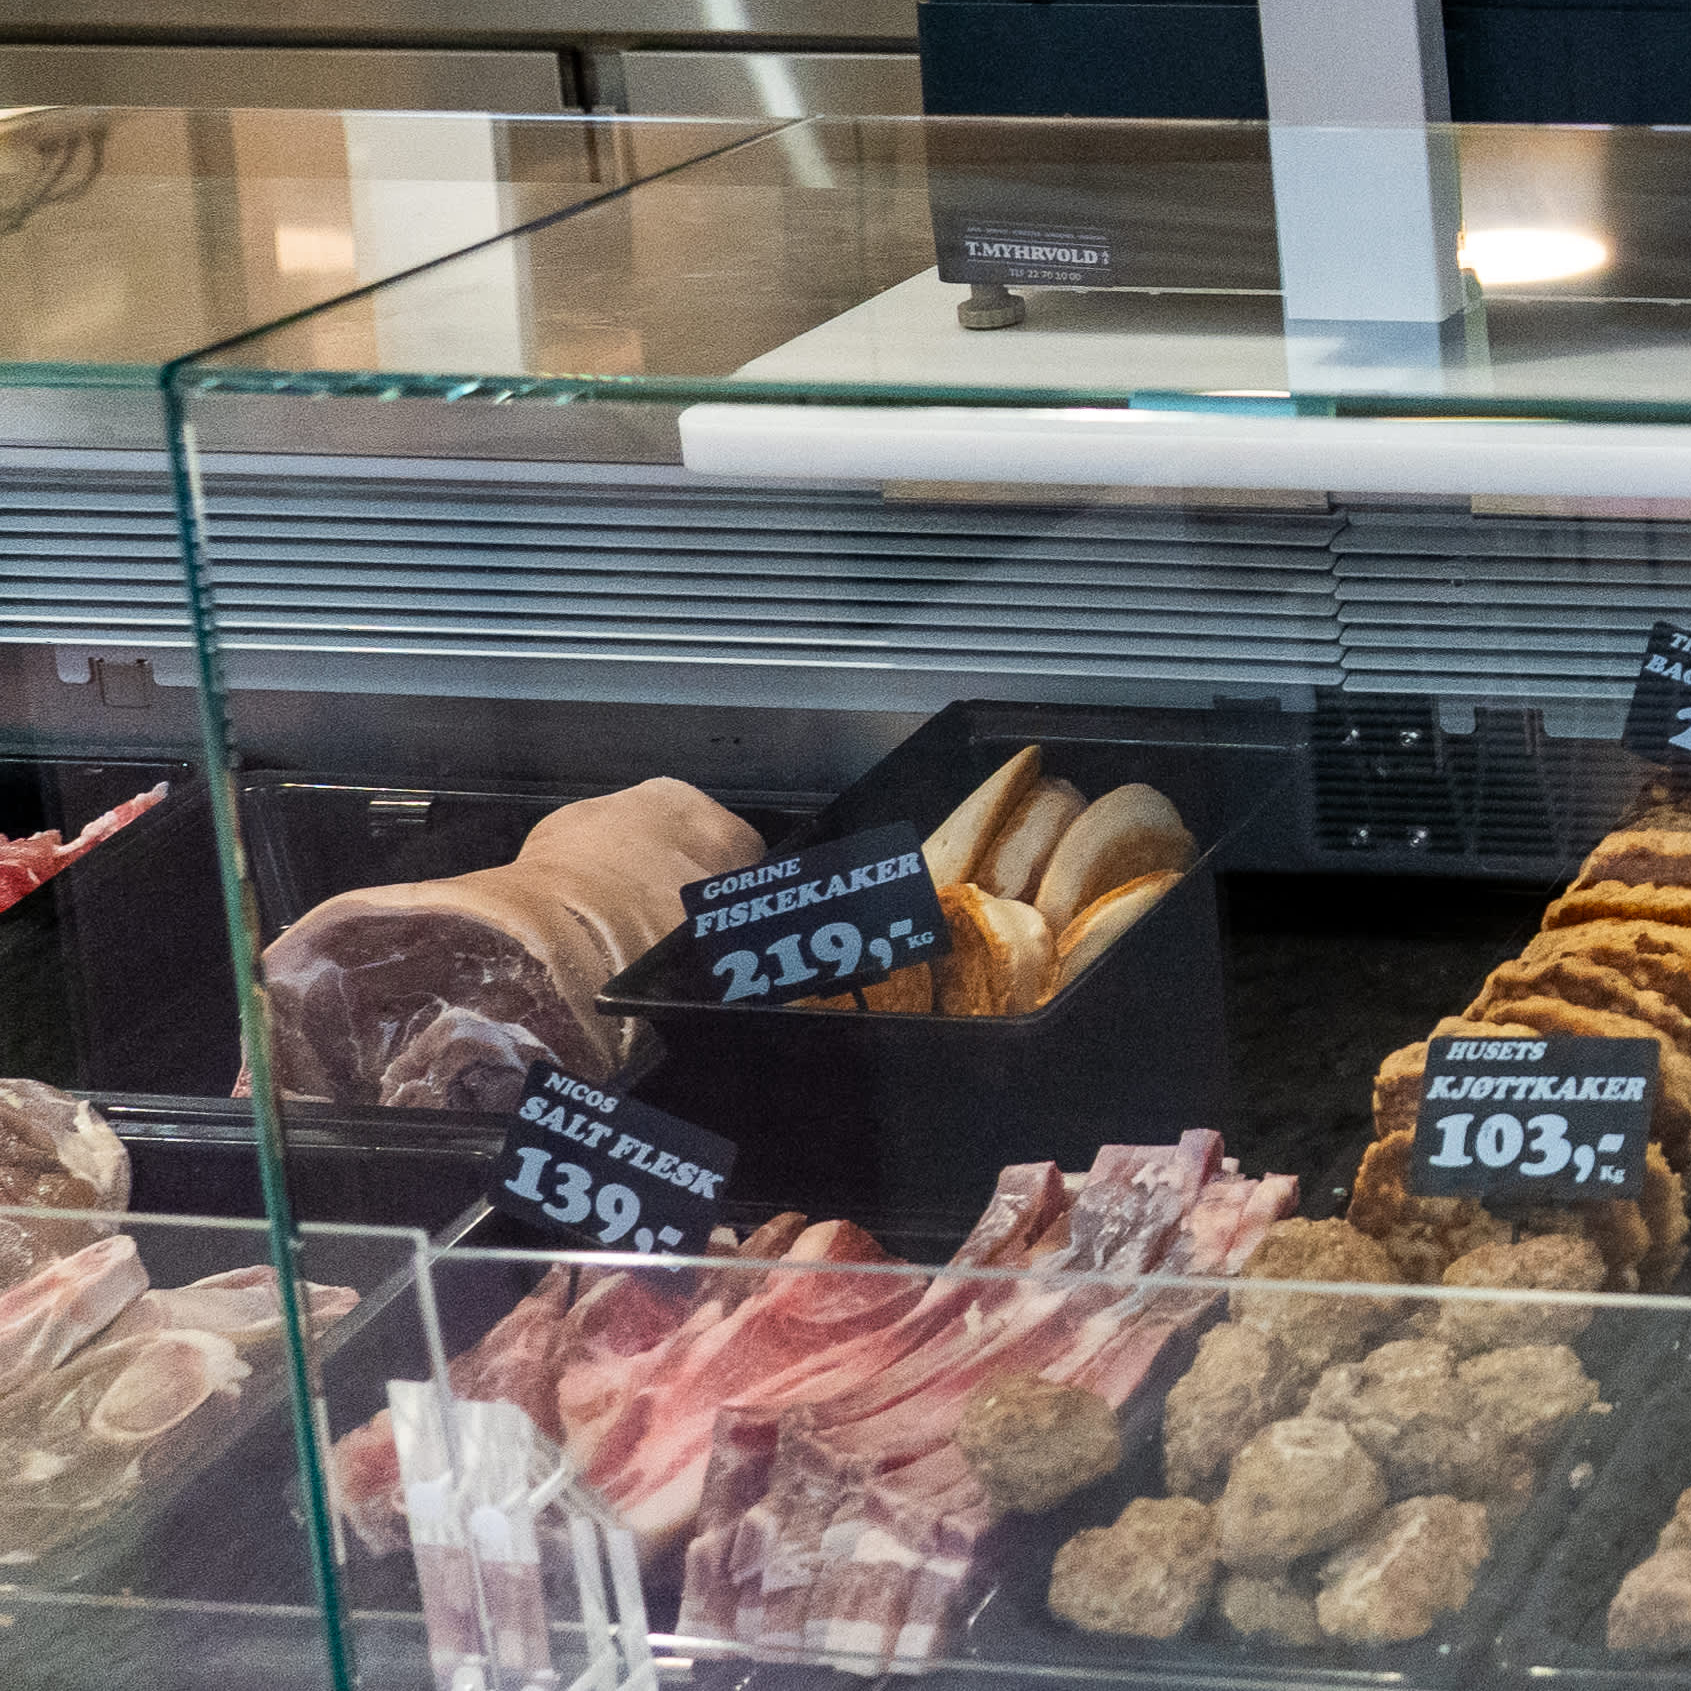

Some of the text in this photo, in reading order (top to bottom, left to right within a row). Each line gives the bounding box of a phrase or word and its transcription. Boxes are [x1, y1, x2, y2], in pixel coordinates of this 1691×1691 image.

[965, 241, 1098, 264] T.MYHRVOLD
[694, 852, 921, 938] FISKEKAKER
[703, 858, 801, 900] GORINE
[712, 919, 913, 1003] 219,-
[1446, 1041, 1547, 1061] HUSETS
[544, 1072, 619, 1113] NICOS
[1426, 1076, 1647, 1101] KJØTTKAKER
[519, 1096, 724, 1199] SALT FLESK
[1429, 1113, 1625, 1183] 103,-
[504, 1147, 683, 1253] 139,-
